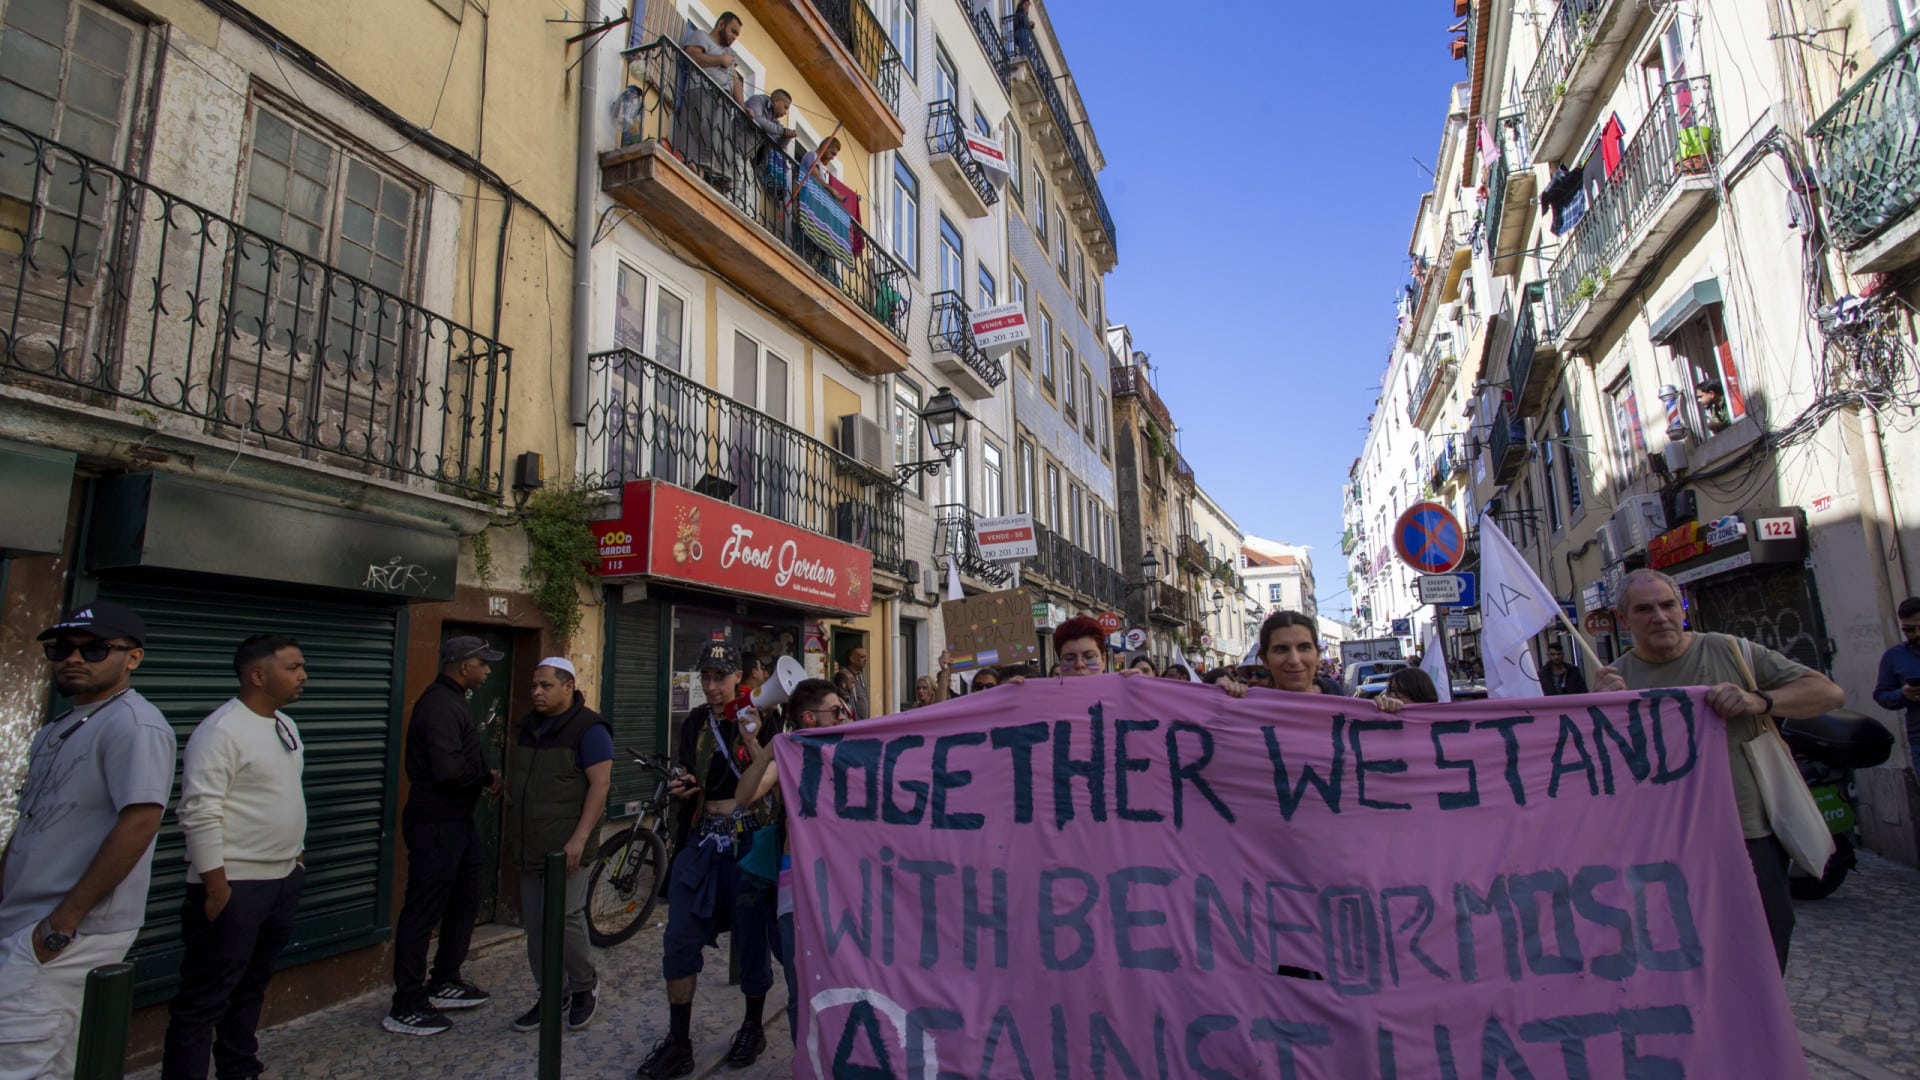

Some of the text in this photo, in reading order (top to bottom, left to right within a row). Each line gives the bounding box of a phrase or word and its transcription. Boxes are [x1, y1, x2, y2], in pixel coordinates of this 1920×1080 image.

[981, 320, 1003, 329] VENDE
[993, 333, 1006, 342] 201
[1009, 330, 1024, 339] 221
[1764, 521, 1792, 536] 122
[600, 531, 633, 546] FOOD
[986, 533, 1010, 541] VENDE
[600, 545, 631, 556] GARDEN
[720, 523, 837, 587] Food Garden
[999, 548, 1011, 557] 201
[1015, 546, 1029, 555] 221
[608, 560, 623, 570] 115
[1099, 614, 1117, 626] ria
[1587, 614, 1609, 628] ria
[789, 689, 1697, 832] TOGETHER WE STAND
